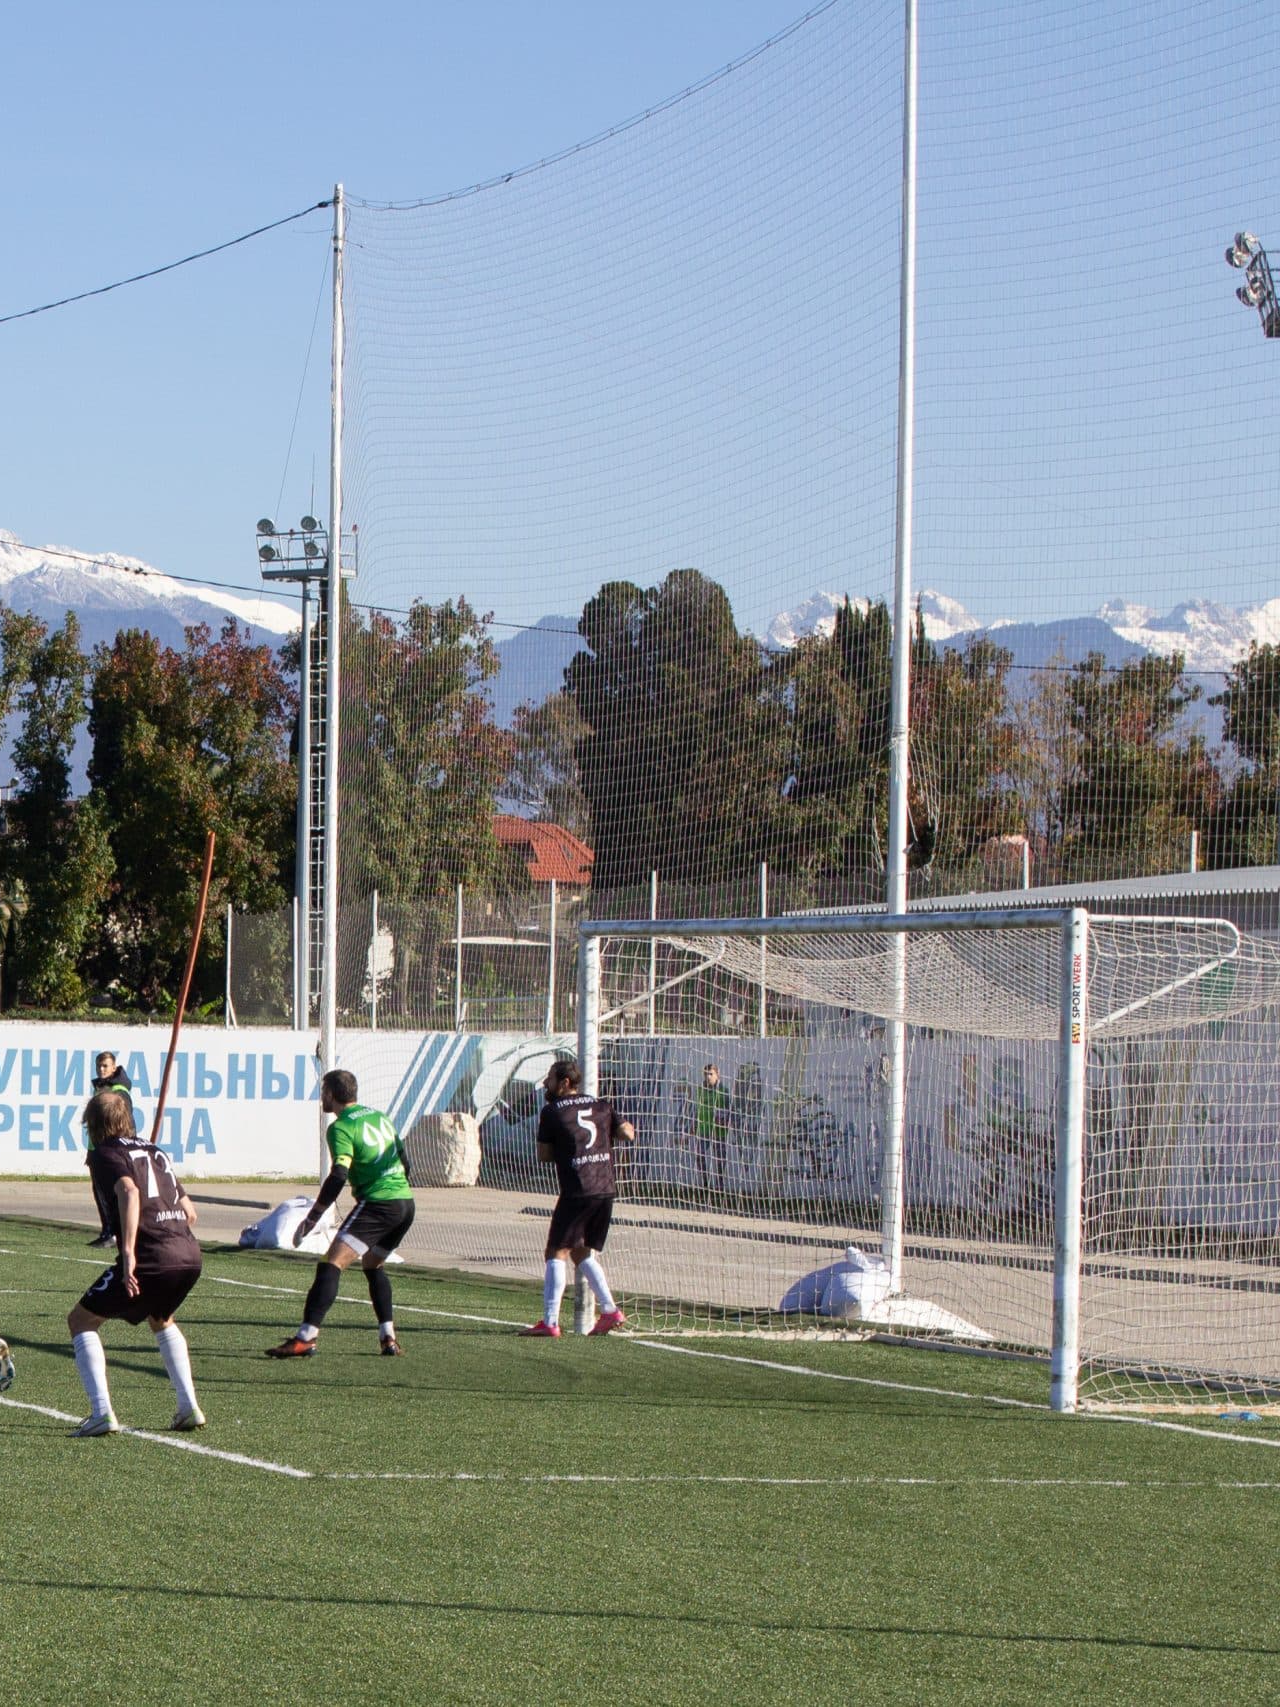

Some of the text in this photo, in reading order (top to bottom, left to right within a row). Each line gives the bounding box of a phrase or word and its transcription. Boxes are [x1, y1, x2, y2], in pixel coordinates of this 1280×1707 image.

[1072, 954, 1082, 1018] SPORTWERK
[362, 1115, 398, 1165] 99
[577, 1107, 598, 1150] 5
[128, 1149, 179, 1205] 73
